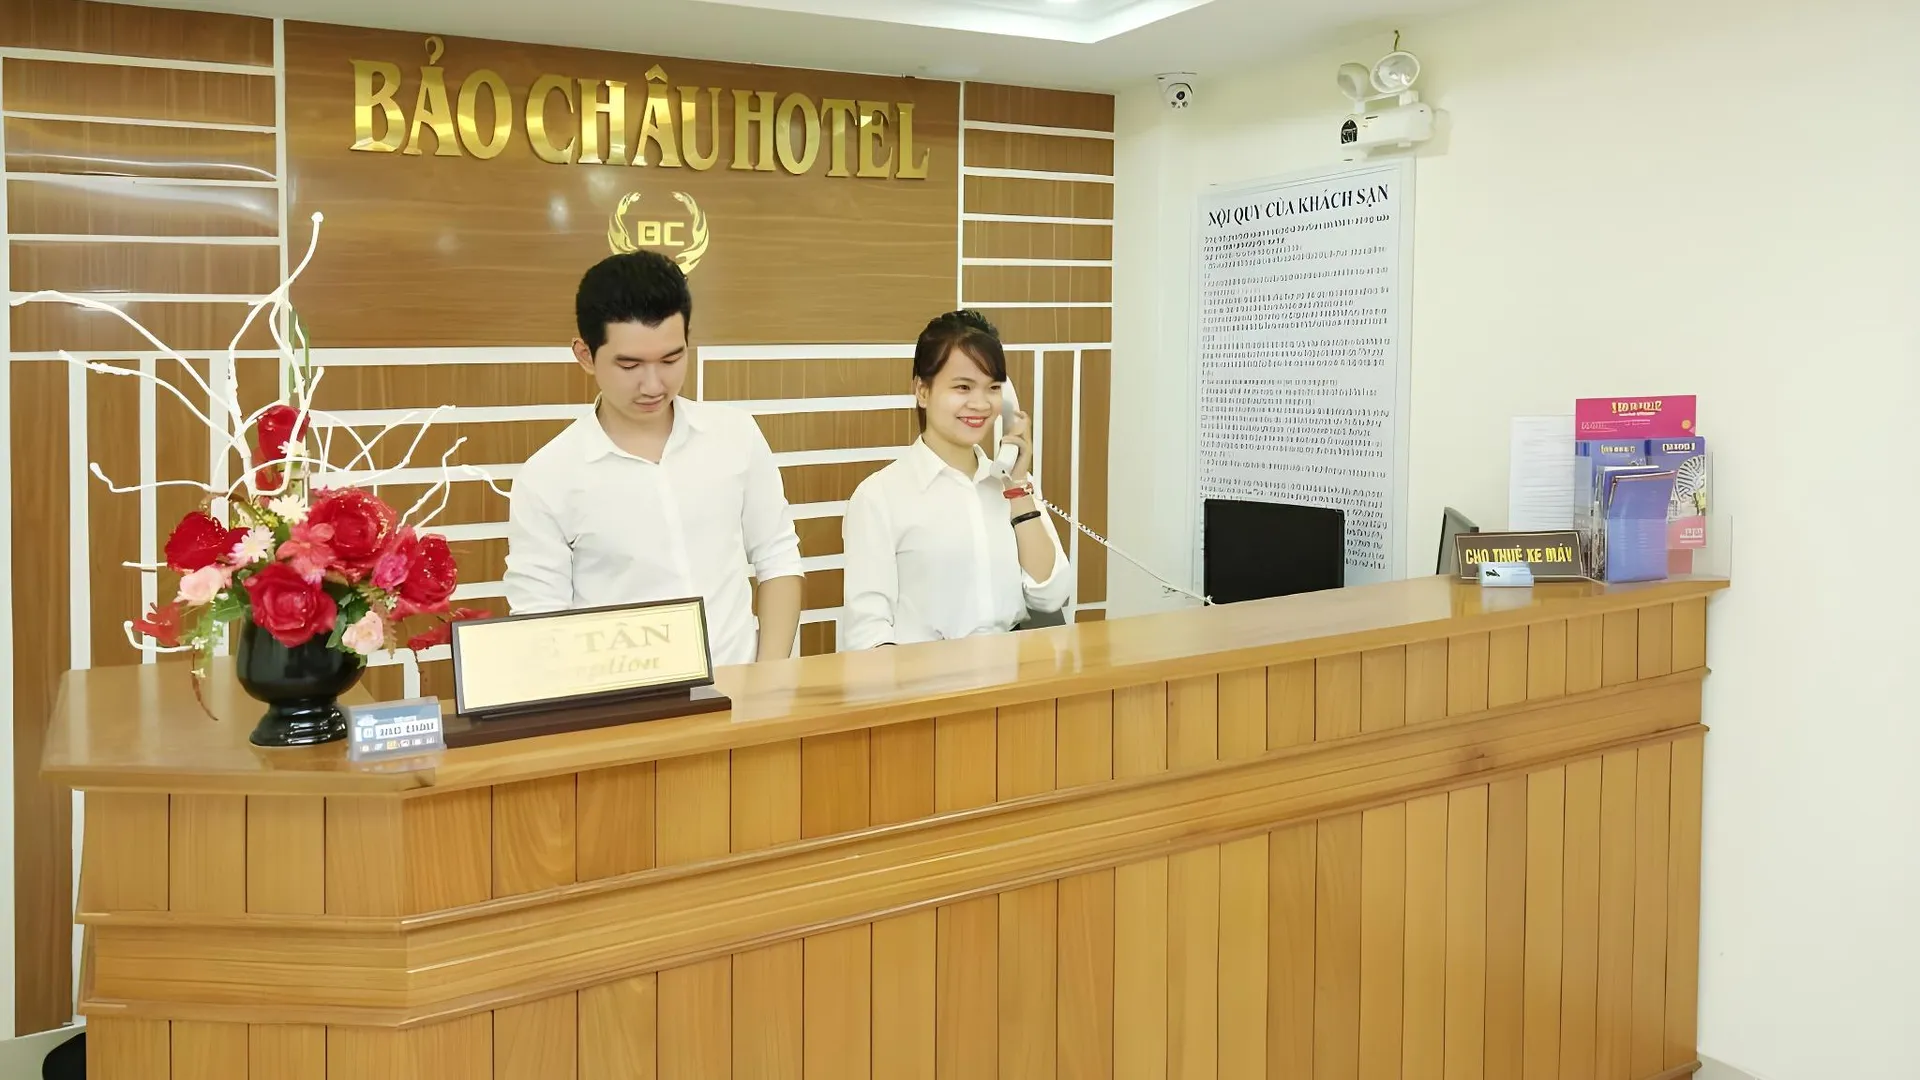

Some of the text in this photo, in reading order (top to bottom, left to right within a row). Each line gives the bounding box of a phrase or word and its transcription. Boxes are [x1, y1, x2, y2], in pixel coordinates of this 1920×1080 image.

[349, 36, 930, 180] BẢO CHÂU HOTEL
[1298, 188, 1352, 214] KHÁCH
[1356, 183, 1388, 208] SẠN
[637, 220, 685, 246] BC
[1465, 548, 1490, 565] CHO
[1526, 548, 1543, 563] XE
[574, 621, 671, 655] TÂN
